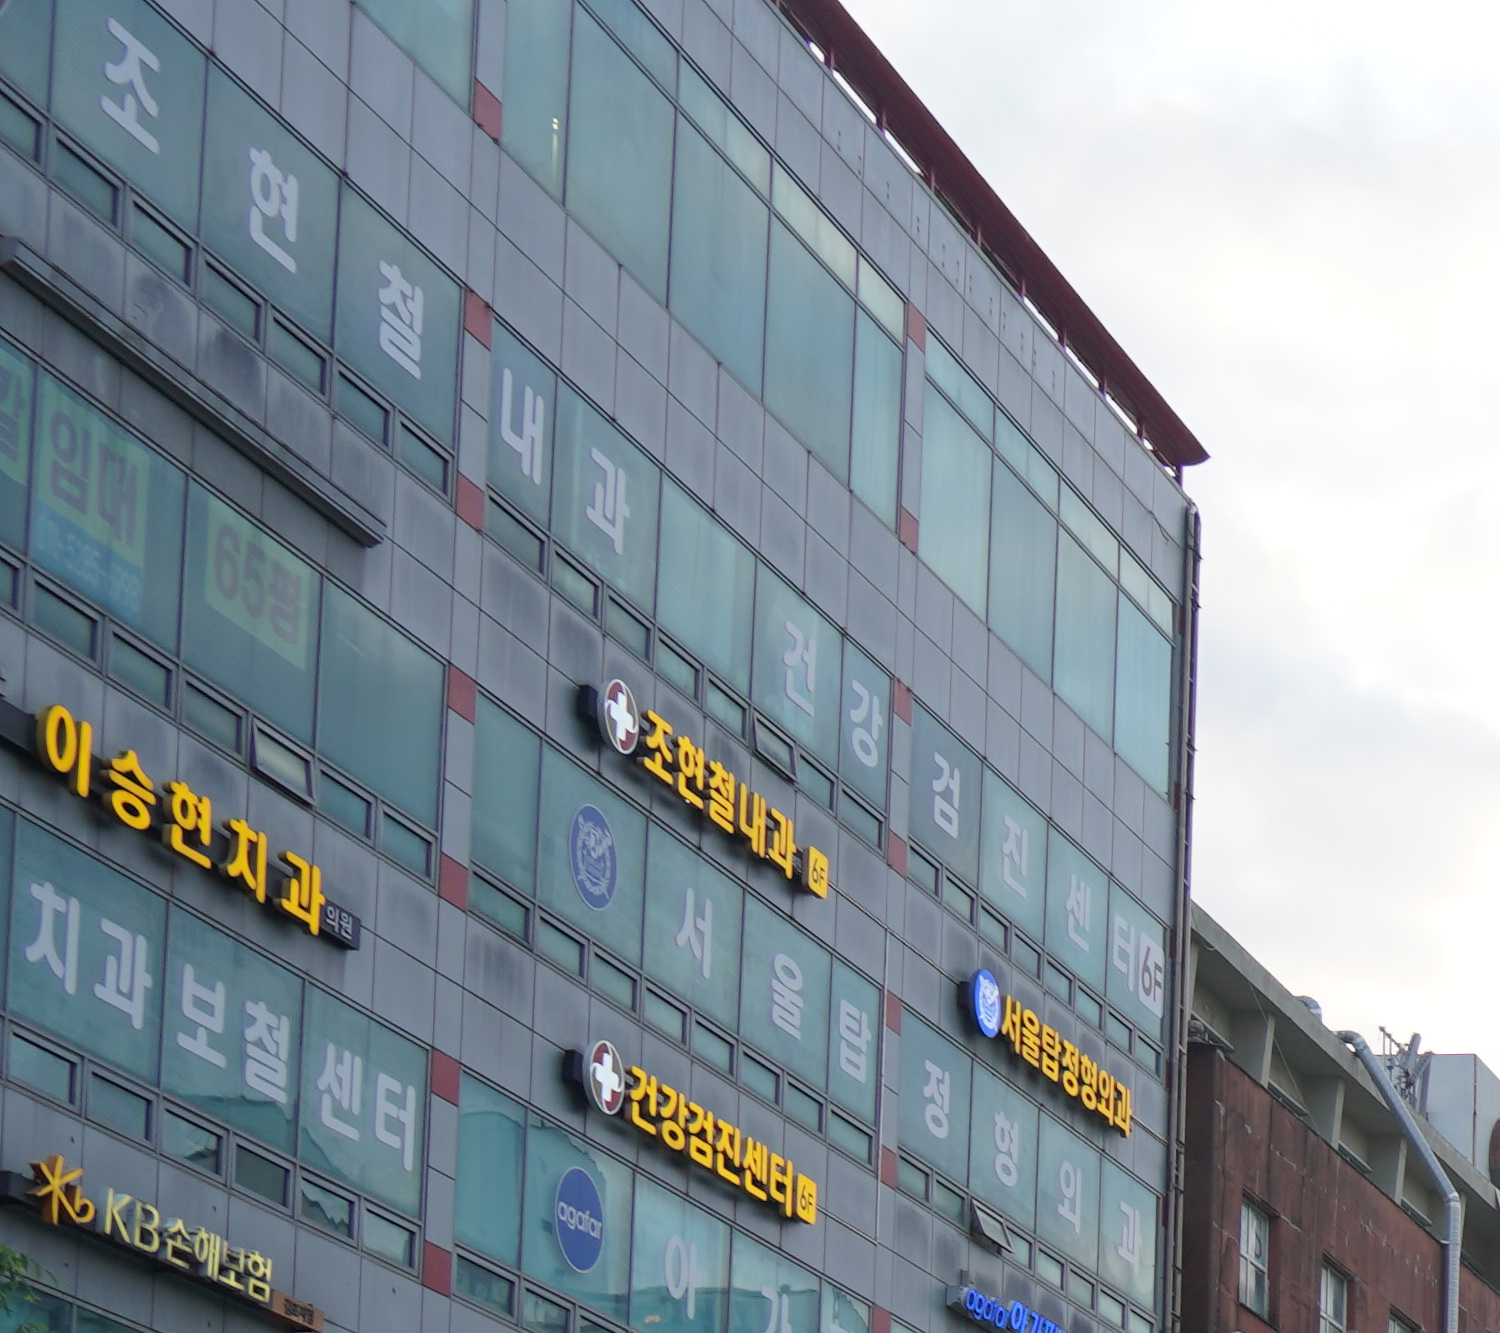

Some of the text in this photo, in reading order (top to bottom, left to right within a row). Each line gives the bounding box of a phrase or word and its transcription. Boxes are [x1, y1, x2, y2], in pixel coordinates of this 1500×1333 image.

[50, 410, 138, 547] 임대
[214, 523, 302, 644] 65평
[43, 704, 353, 940] 이승현치과 의원
[643, 709, 797, 879] 조현철내과
[628, 1065, 795, 1217] 건강검진센터
[103, 1187, 273, 1303] KB손해보험
